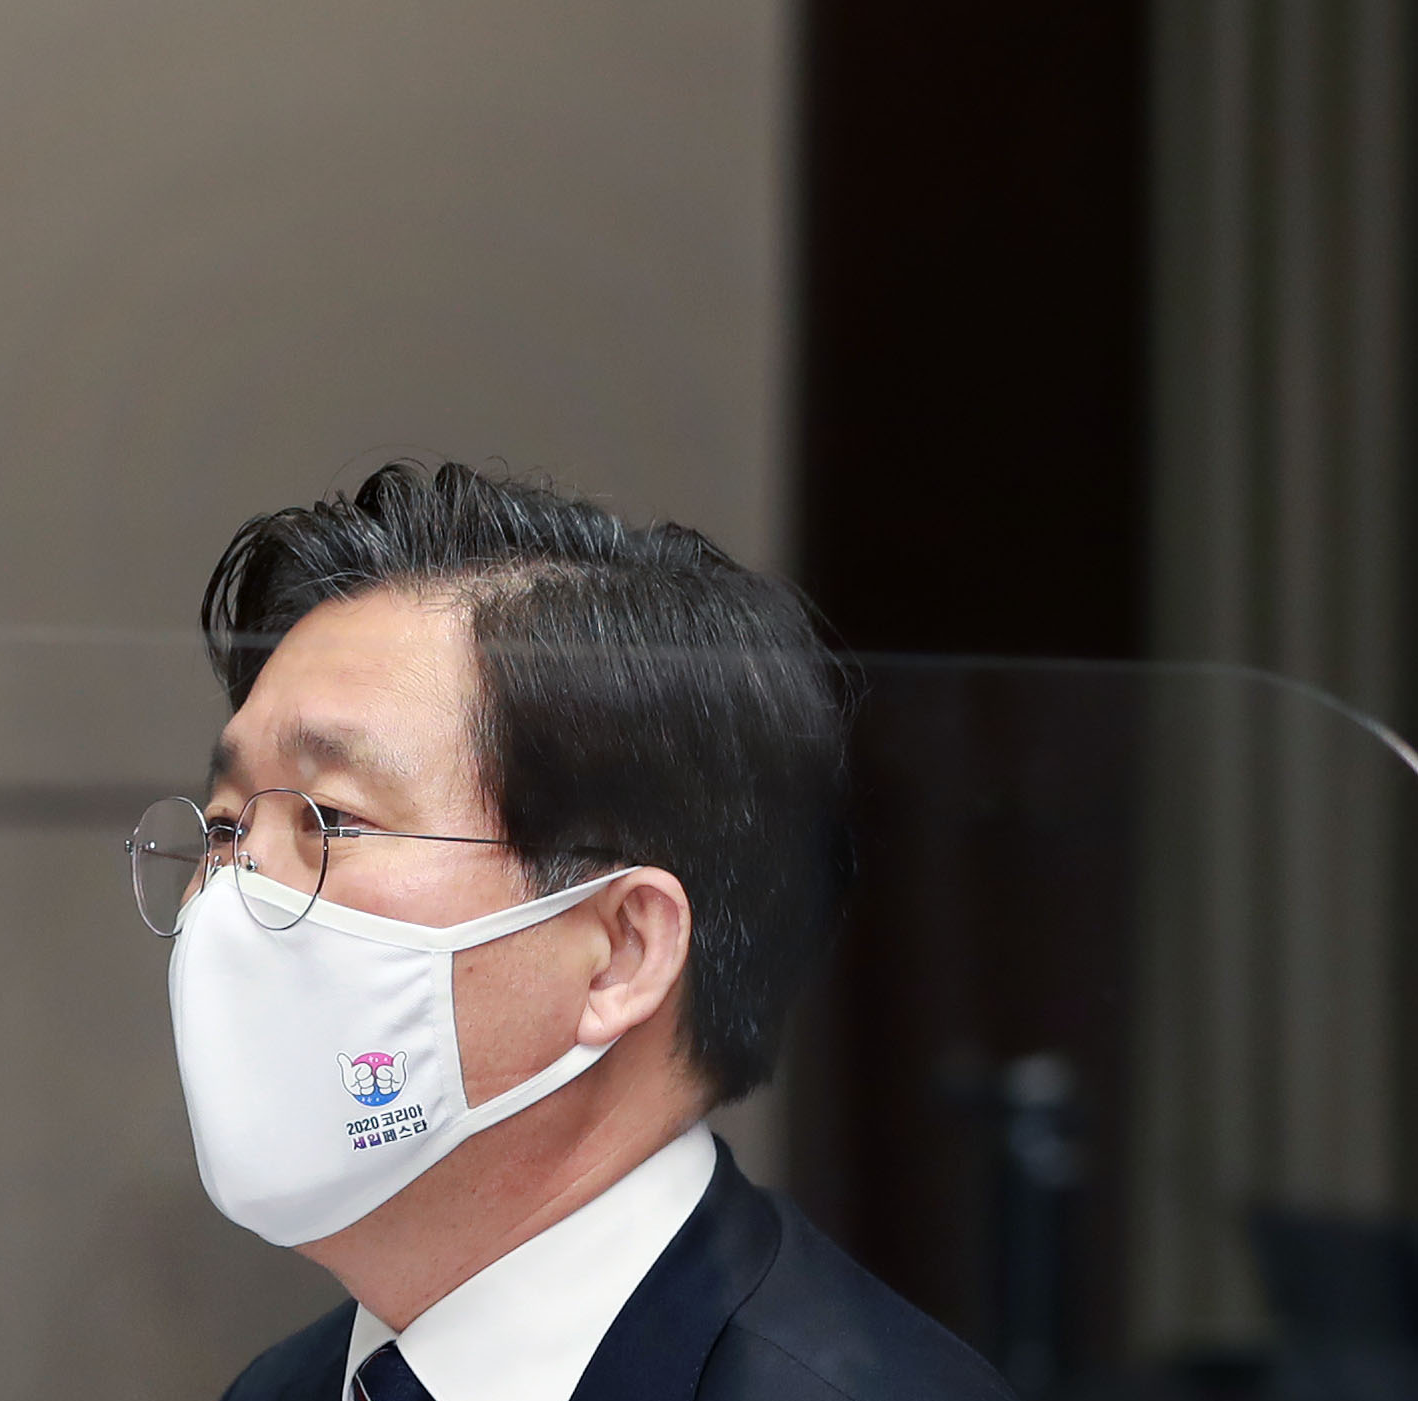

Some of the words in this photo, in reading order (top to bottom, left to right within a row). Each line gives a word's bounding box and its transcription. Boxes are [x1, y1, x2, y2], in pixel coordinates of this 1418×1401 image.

[347, 1117, 380, 1136] 2020
[381, 1104, 424, 1127] 코리아
[353, 1119, 428, 1150] 세일페스타
